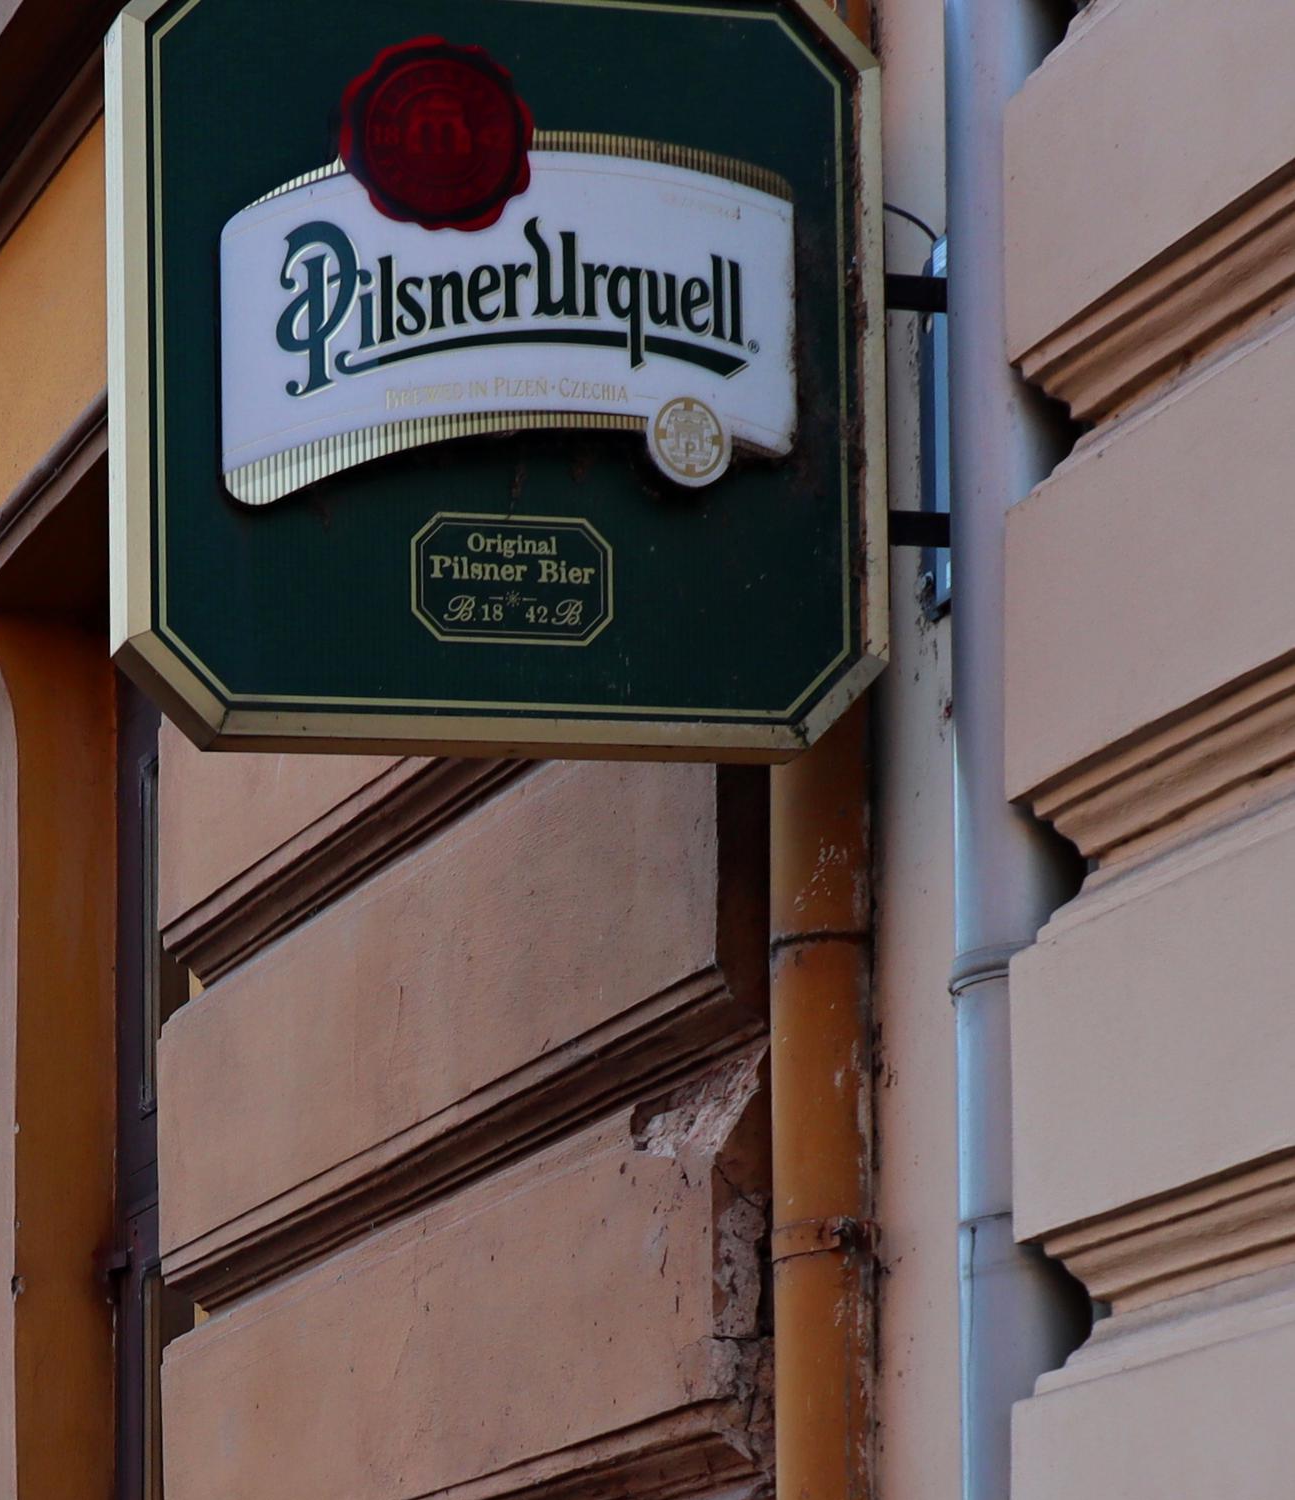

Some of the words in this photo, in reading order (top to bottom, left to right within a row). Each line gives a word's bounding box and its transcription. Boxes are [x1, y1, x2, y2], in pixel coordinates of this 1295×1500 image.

[275, 220, 533, 397] Pilsner
[523, 216, 746, 370] Urquell
[467, 532, 557, 559] Original
[429, 555, 528, 582] Pilsner
[537, 559, 596, 585] Bier
[481, 604, 504, 621] 18
[525, 606, 548, 624] 42
